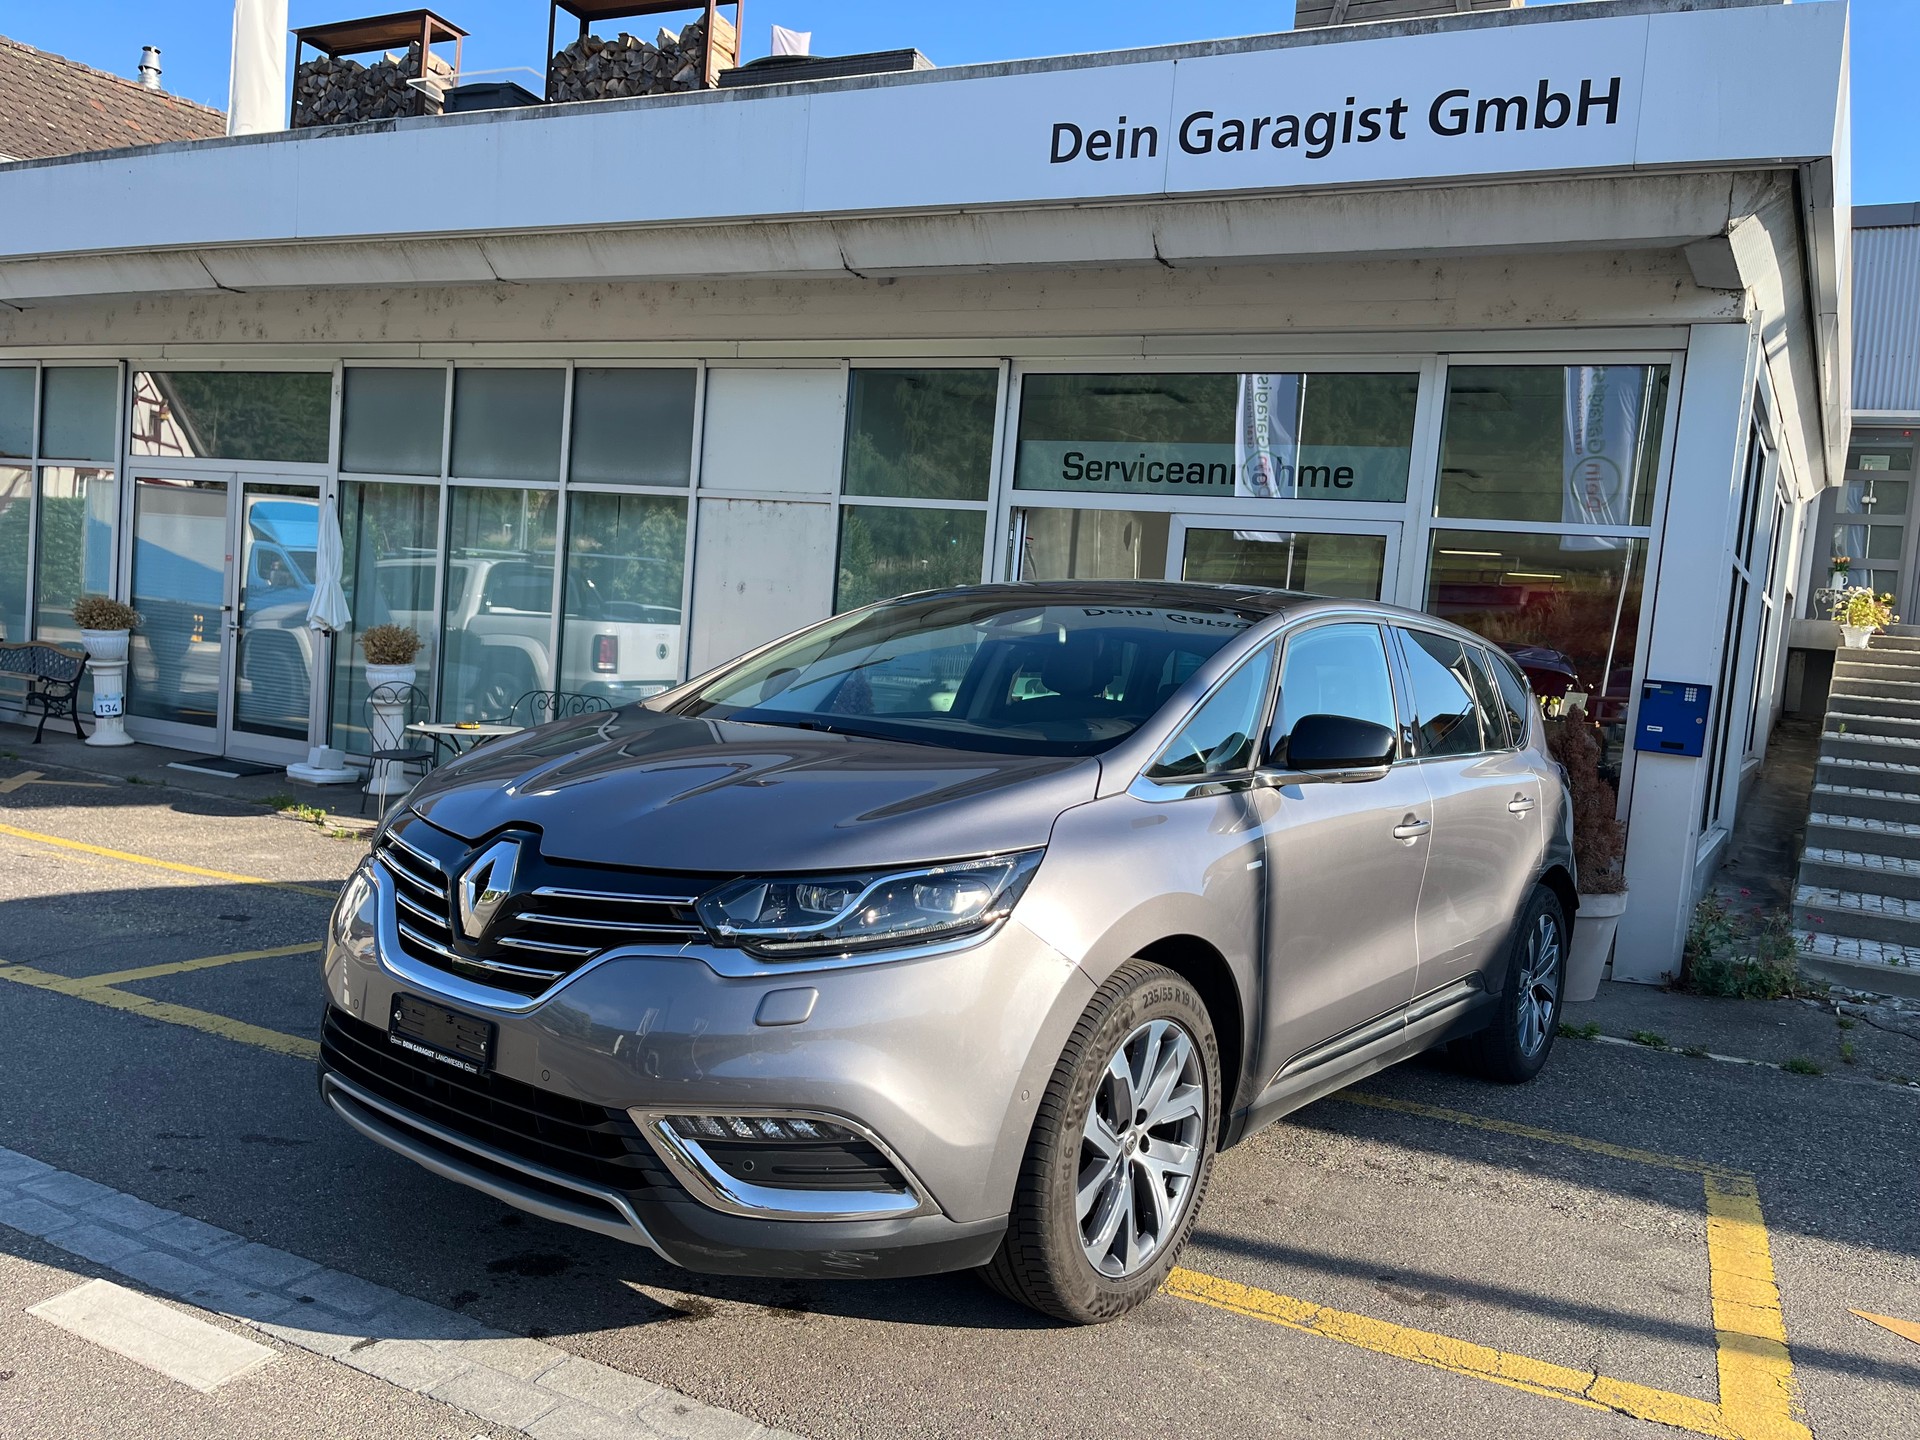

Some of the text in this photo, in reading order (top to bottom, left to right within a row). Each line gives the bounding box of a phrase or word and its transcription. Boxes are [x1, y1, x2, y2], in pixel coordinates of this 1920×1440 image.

[1050, 77, 1621, 163] Dein Garagist GmbH
[100, 704, 118, 713] 134
[1142, 986, 1173, 1009] 235/55
[402, 1040, 414, 1050] DEIN
[413, 1044, 435, 1058] GARAGIST
[435, 1053, 464, 1069] LANGWIESEN
[1064, 1146, 1074, 1158] 6
[1172, 1153, 1215, 1263] Continental
